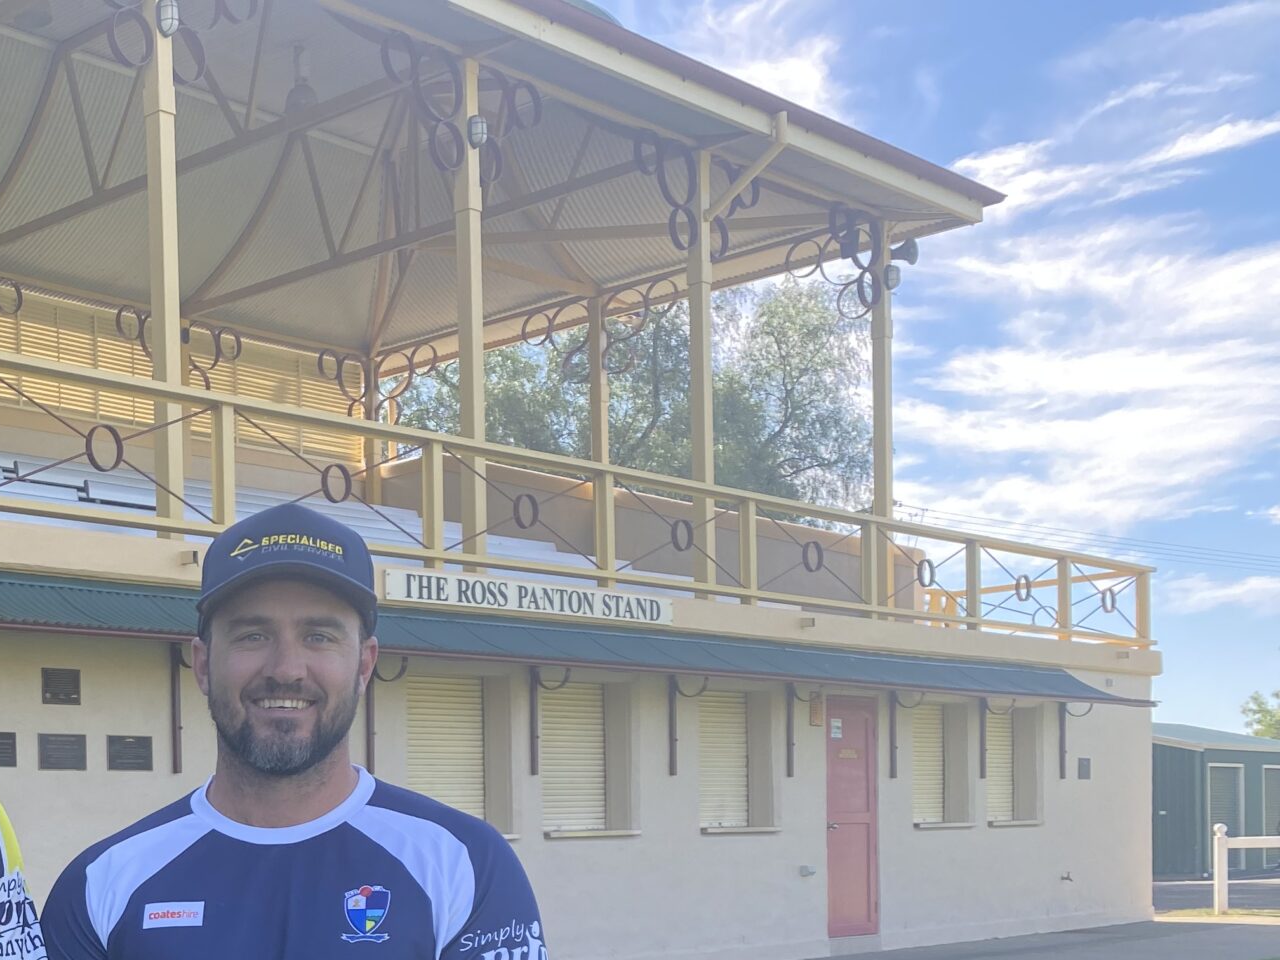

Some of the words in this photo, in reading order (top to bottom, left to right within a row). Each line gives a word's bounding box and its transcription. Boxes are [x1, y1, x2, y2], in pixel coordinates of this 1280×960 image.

[261, 534, 344, 555] SPECIALISED
[404, 572, 449, 602] THE
[456, 578, 509, 608] ROSS
[517, 584, 596, 616] PANTON
[602, 593, 661, 622] STAND
[459, 919, 525, 952] Simply
